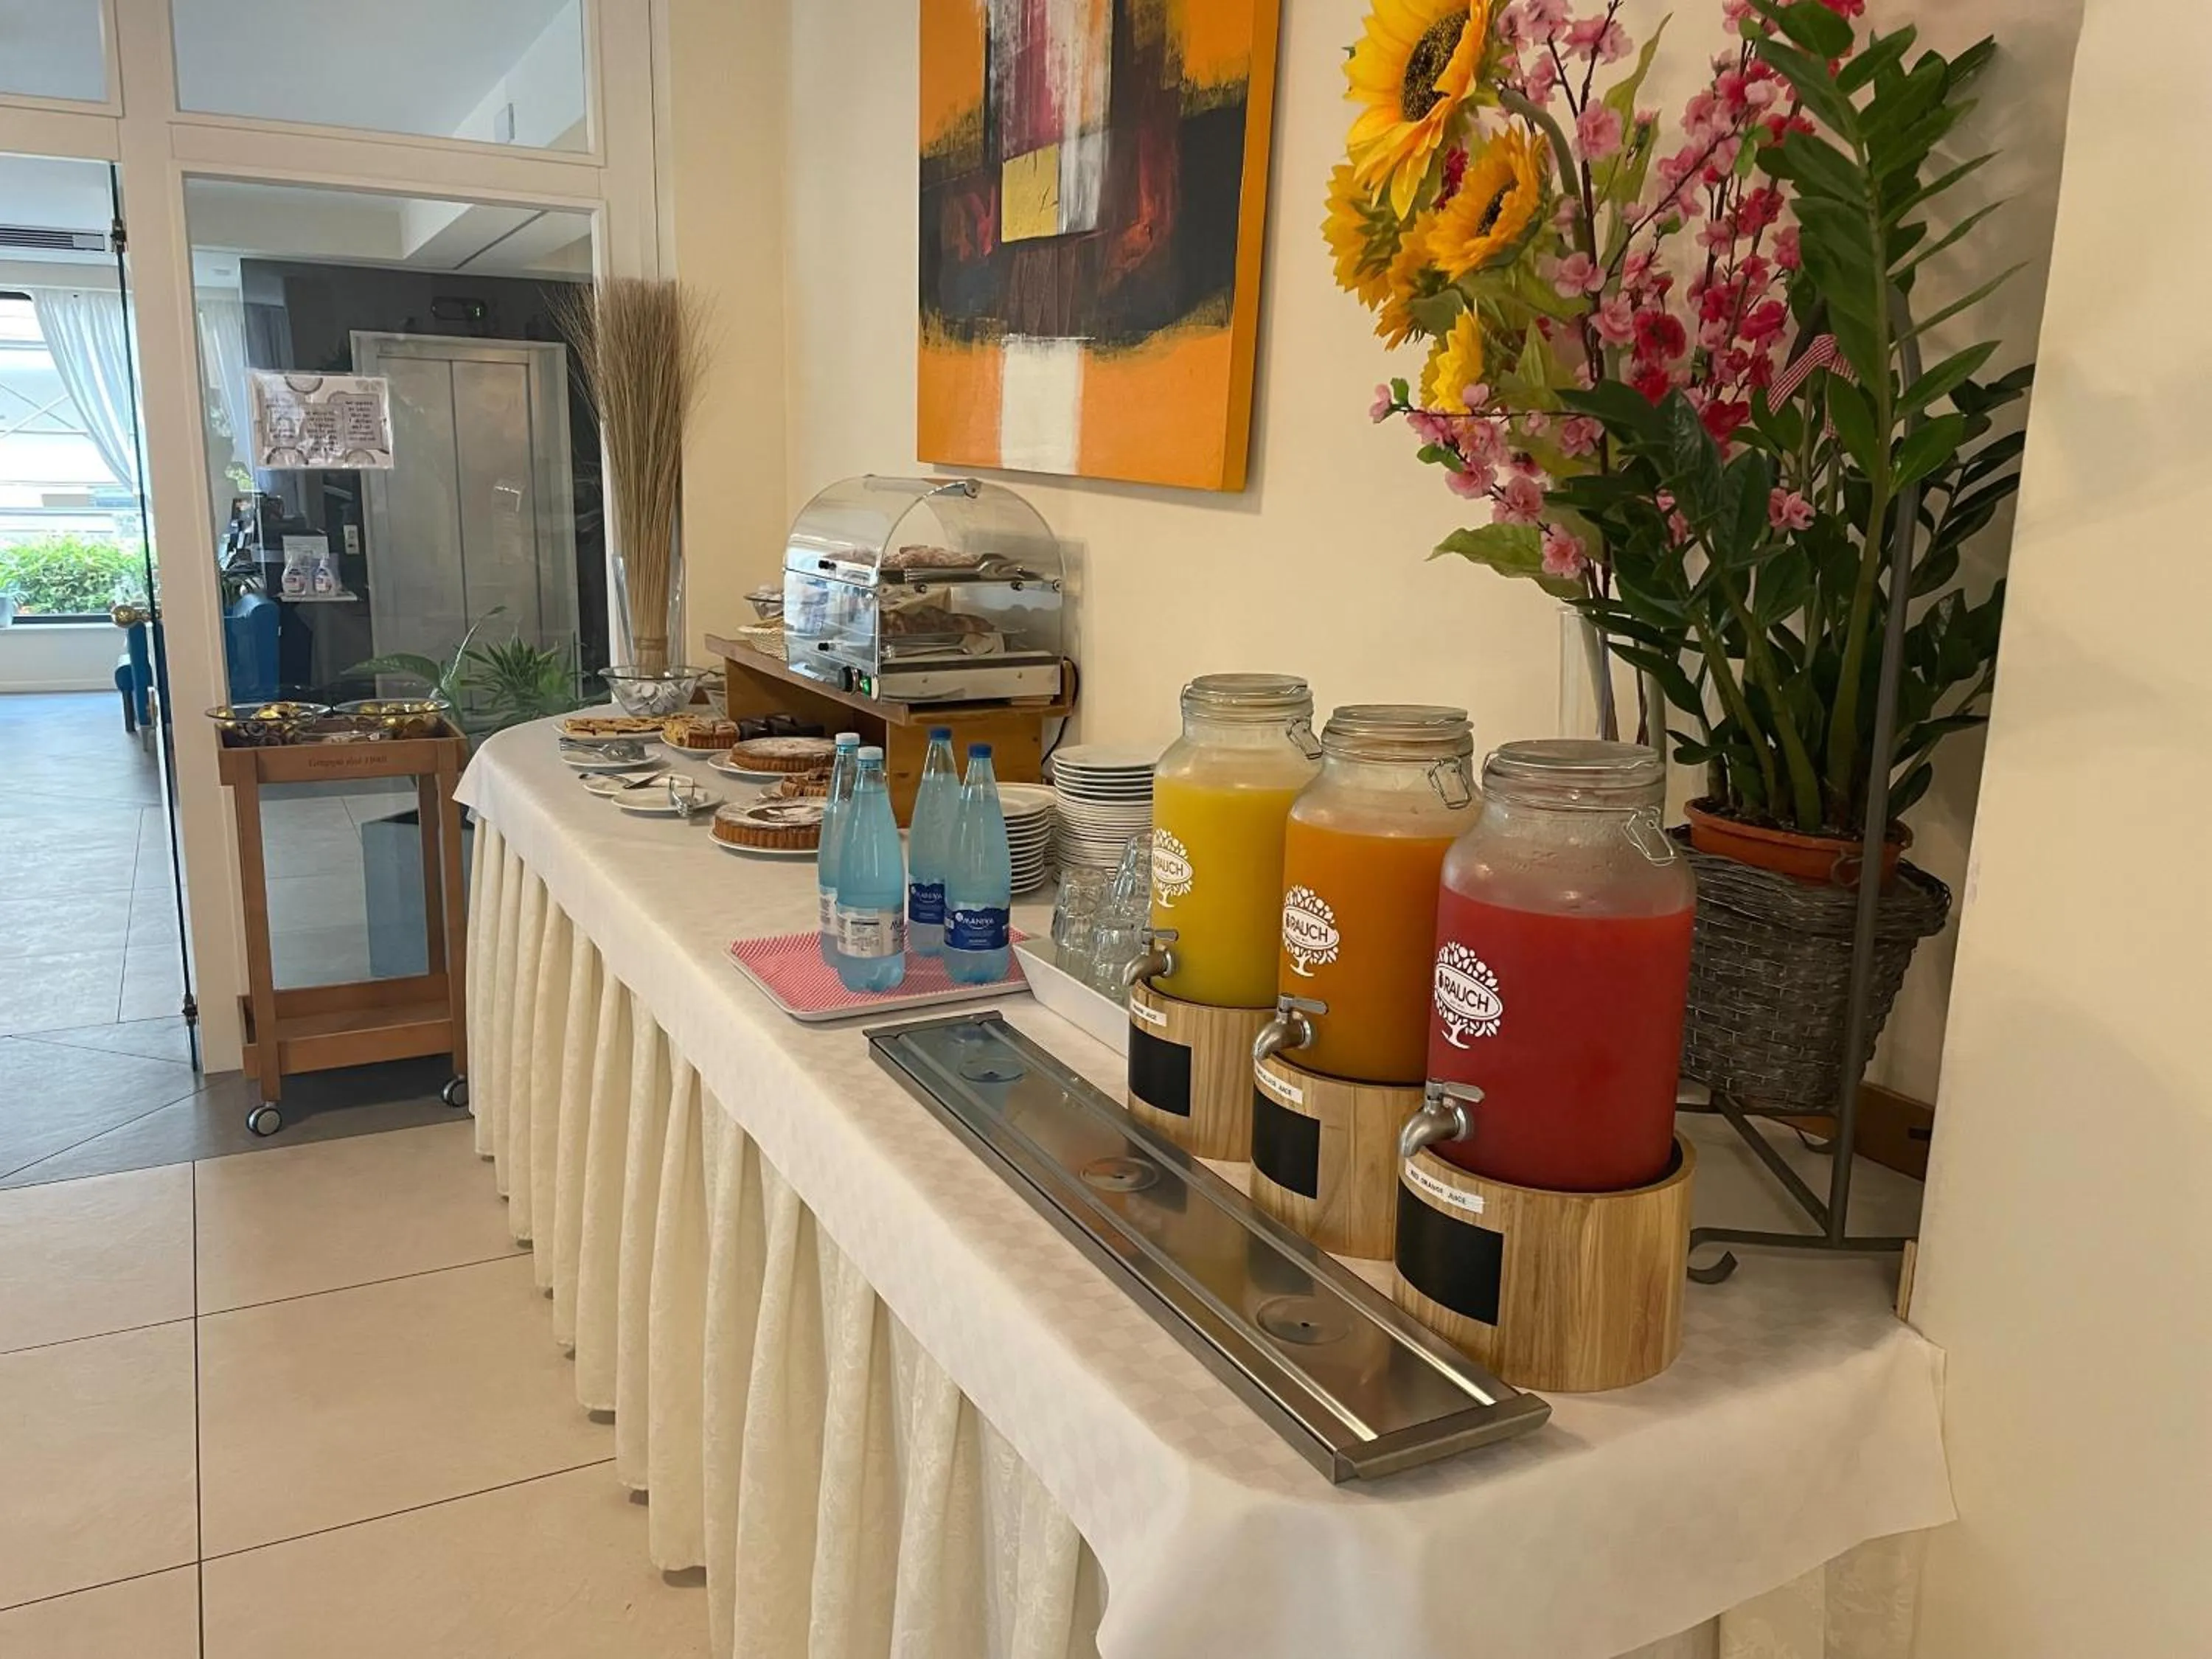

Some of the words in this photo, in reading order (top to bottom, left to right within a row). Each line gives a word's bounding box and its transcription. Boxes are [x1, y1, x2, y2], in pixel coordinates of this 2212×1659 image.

[1155, 855, 1183, 877] RAUCH
[962, 917, 995, 926] MANIVA
[1290, 916, 1328, 943] RAUCH
[1444, 975, 1489, 1012] RAUCH
